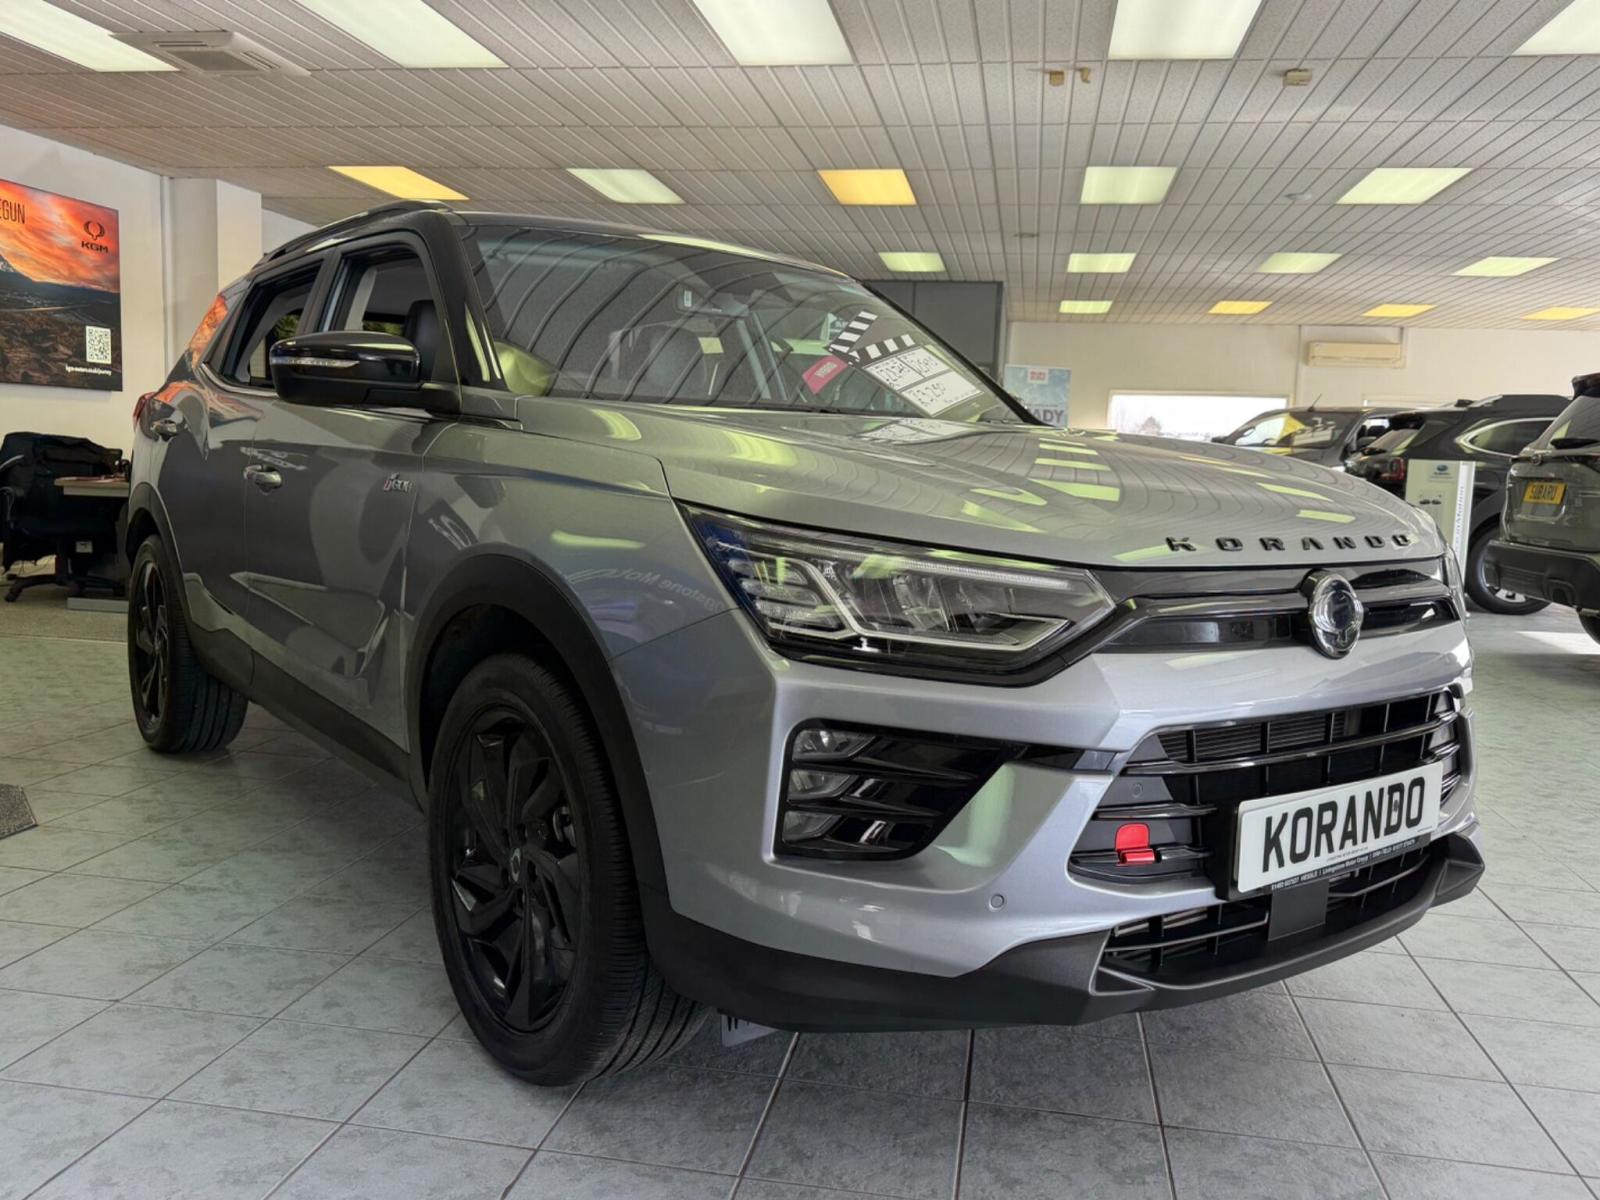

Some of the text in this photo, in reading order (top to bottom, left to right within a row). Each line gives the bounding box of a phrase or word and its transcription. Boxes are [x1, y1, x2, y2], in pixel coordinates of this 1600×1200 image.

[81, 241, 109, 253] KGM
[1029, 408, 1064, 423] ADY
[1165, 534, 1413, 551] KORANDO
[1262, 776, 1425, 873] KORANDO
